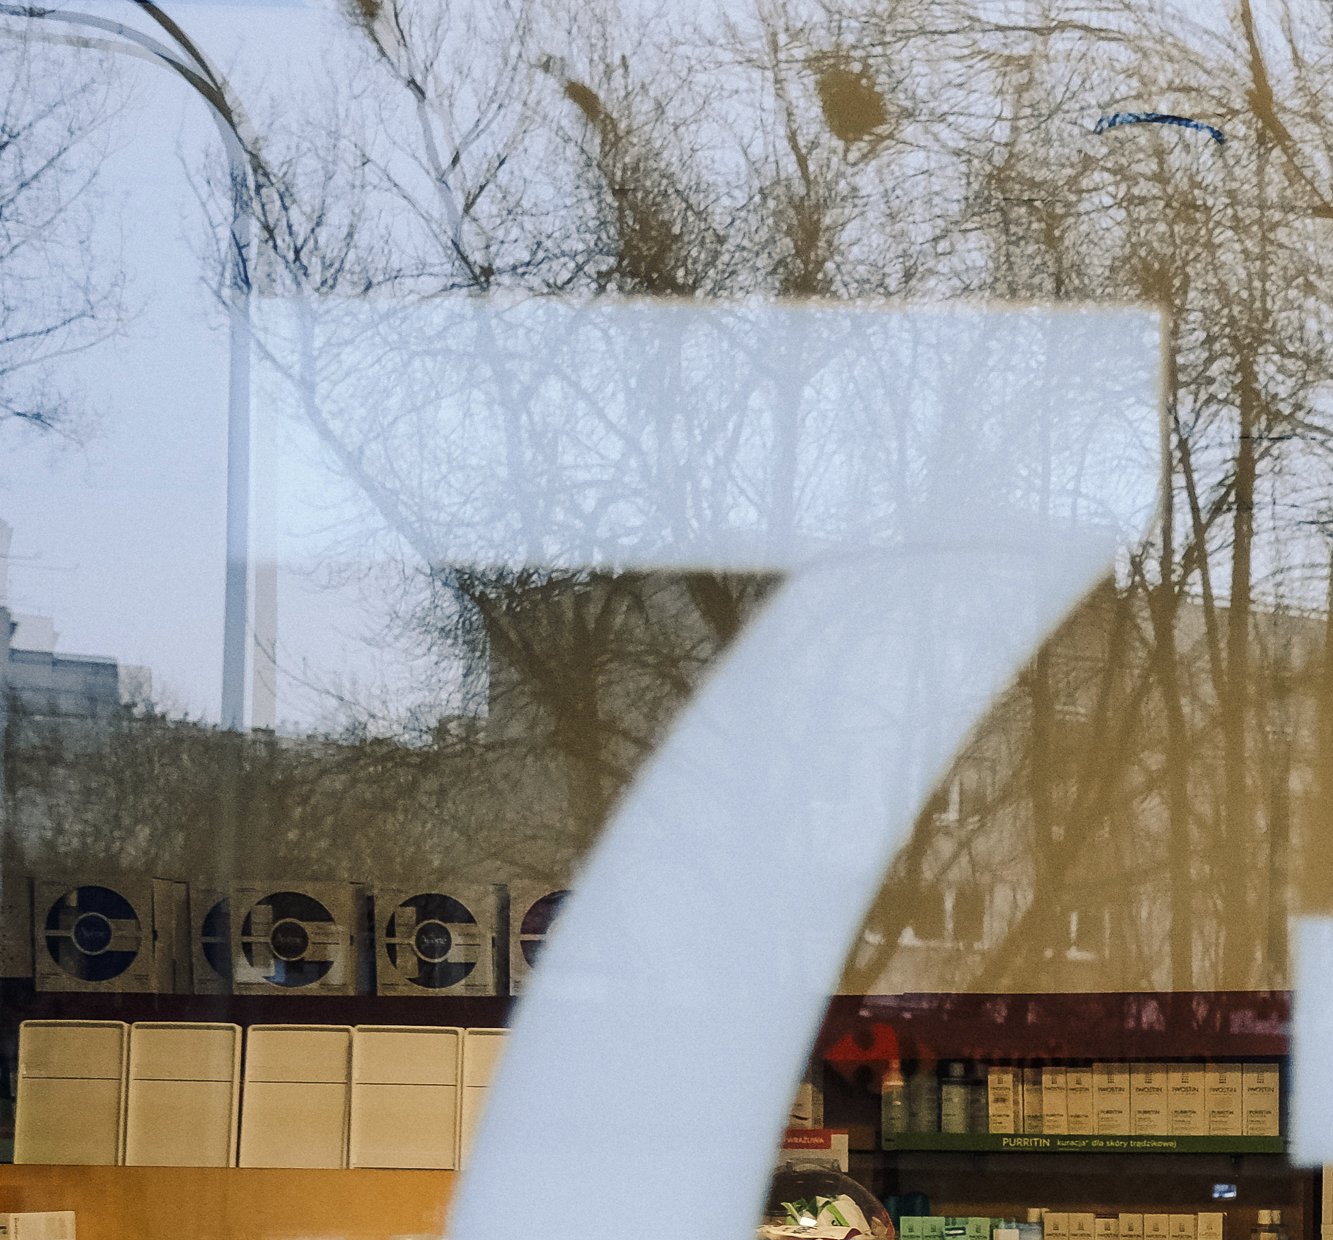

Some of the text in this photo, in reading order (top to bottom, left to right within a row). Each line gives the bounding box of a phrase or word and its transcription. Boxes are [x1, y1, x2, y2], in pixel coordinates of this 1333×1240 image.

[1002, 1138, 1050, 1147] PURRITIN
[1091, 1139, 1104, 1147] dla
[1106, 1139, 1128, 1148] skóry
